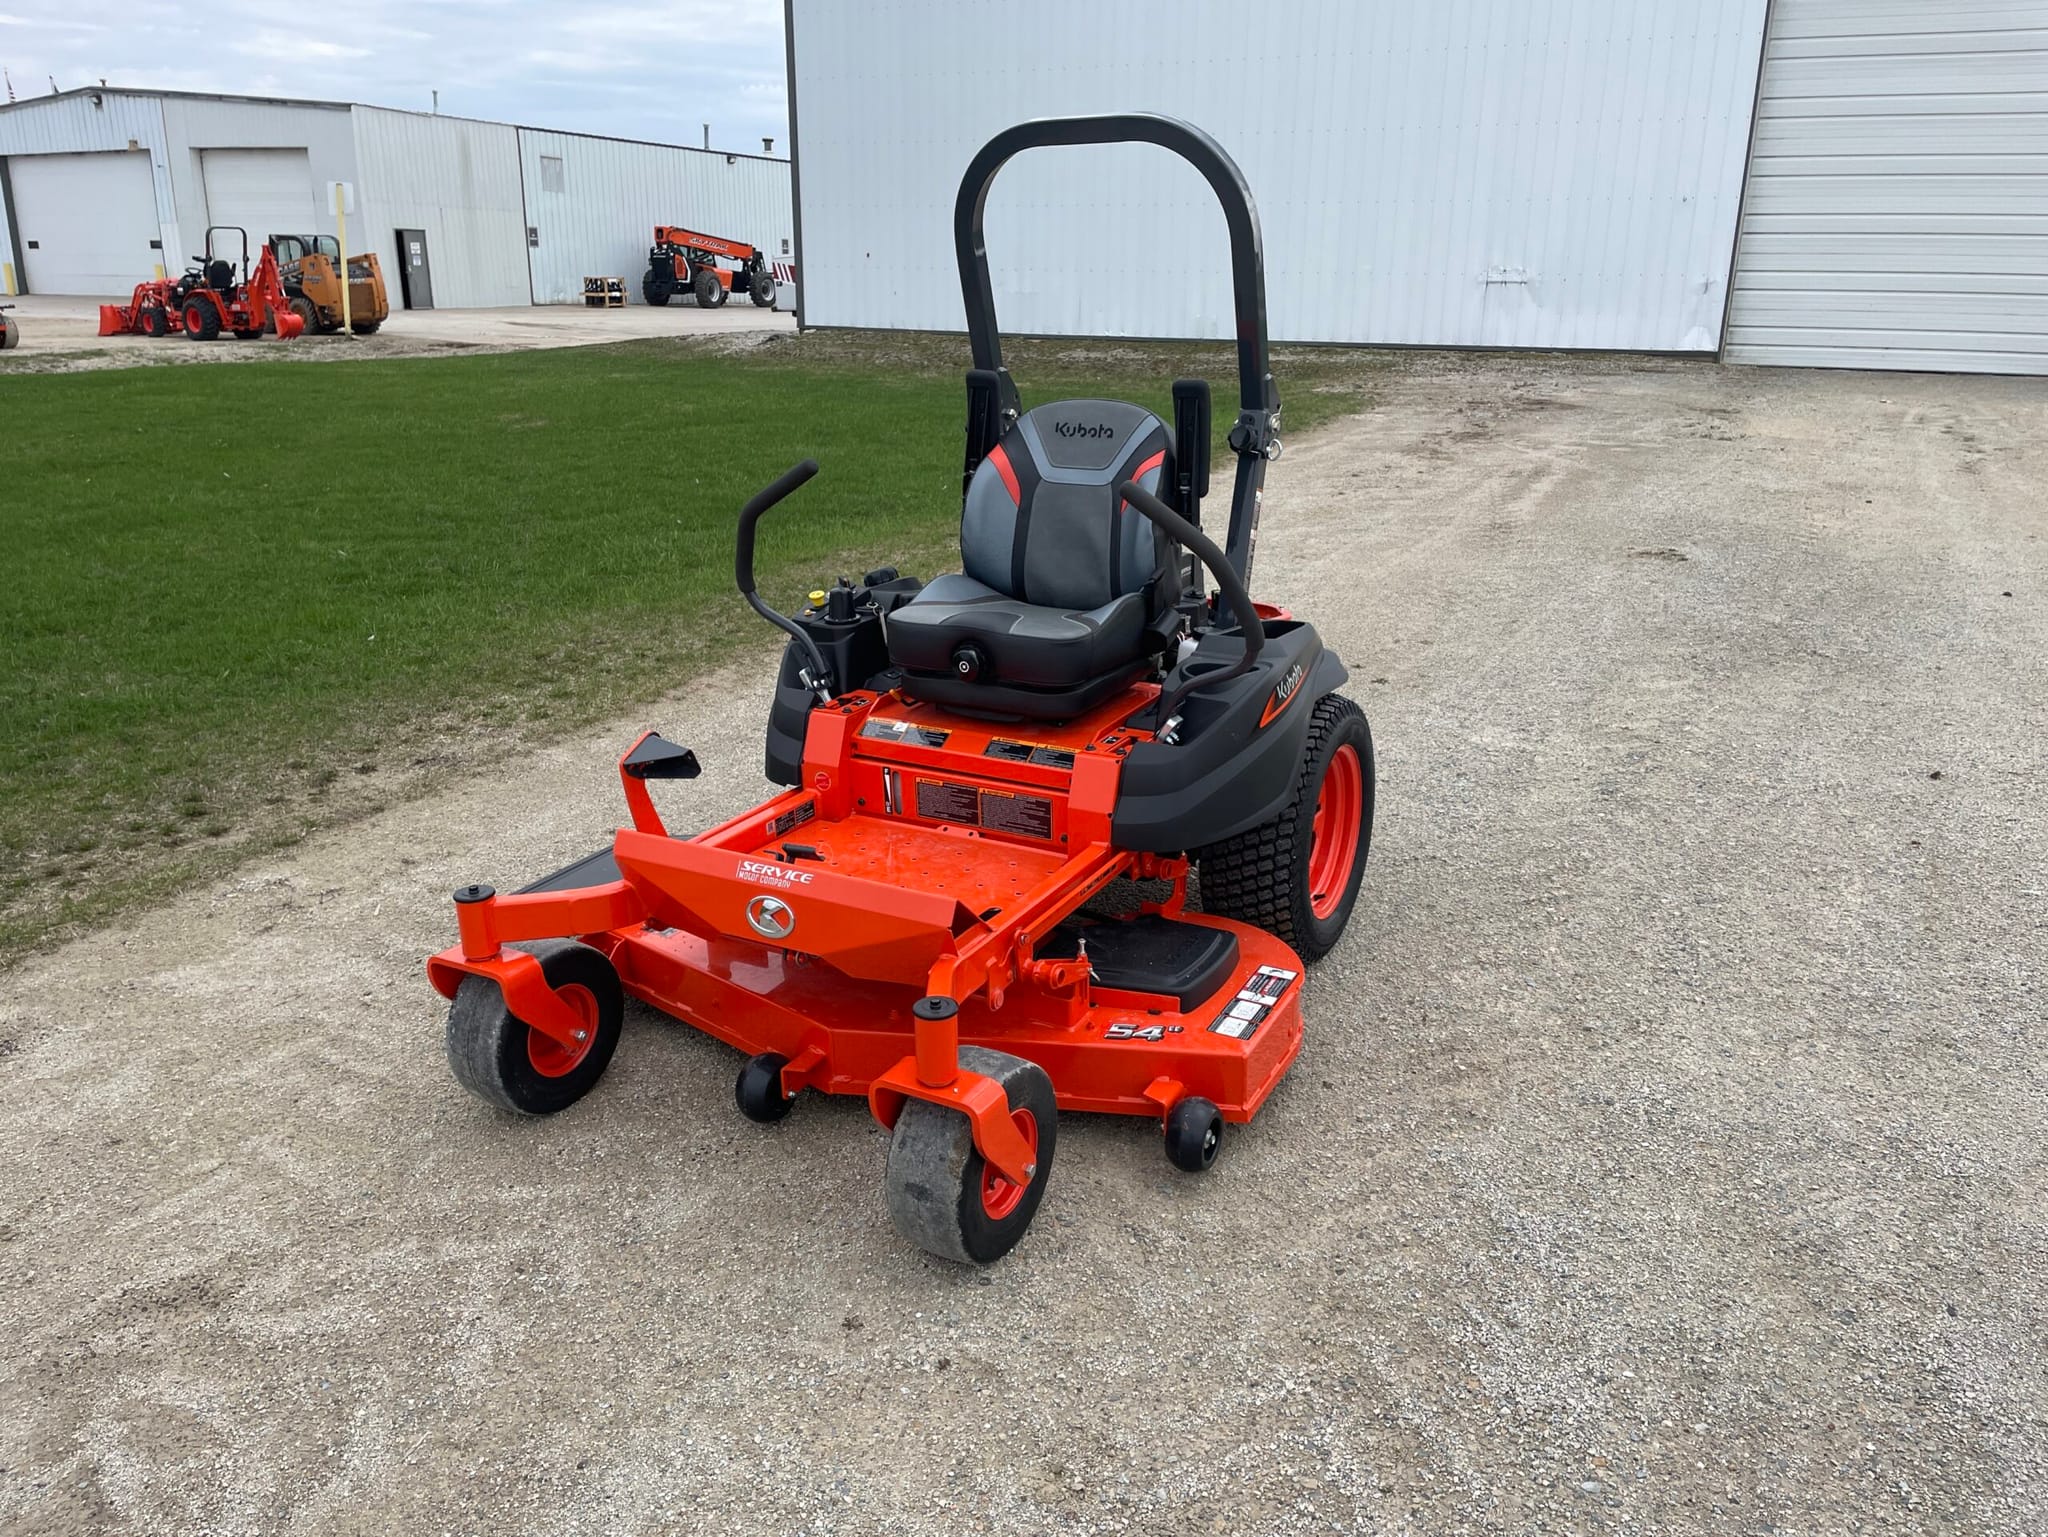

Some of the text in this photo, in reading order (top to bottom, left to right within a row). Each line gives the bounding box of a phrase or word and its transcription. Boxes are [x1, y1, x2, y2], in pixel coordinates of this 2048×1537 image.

[1055, 421, 1114, 439] Kubota
[1276, 664, 1303, 699] Kubota
[740, 861, 814, 884] SERVICE
